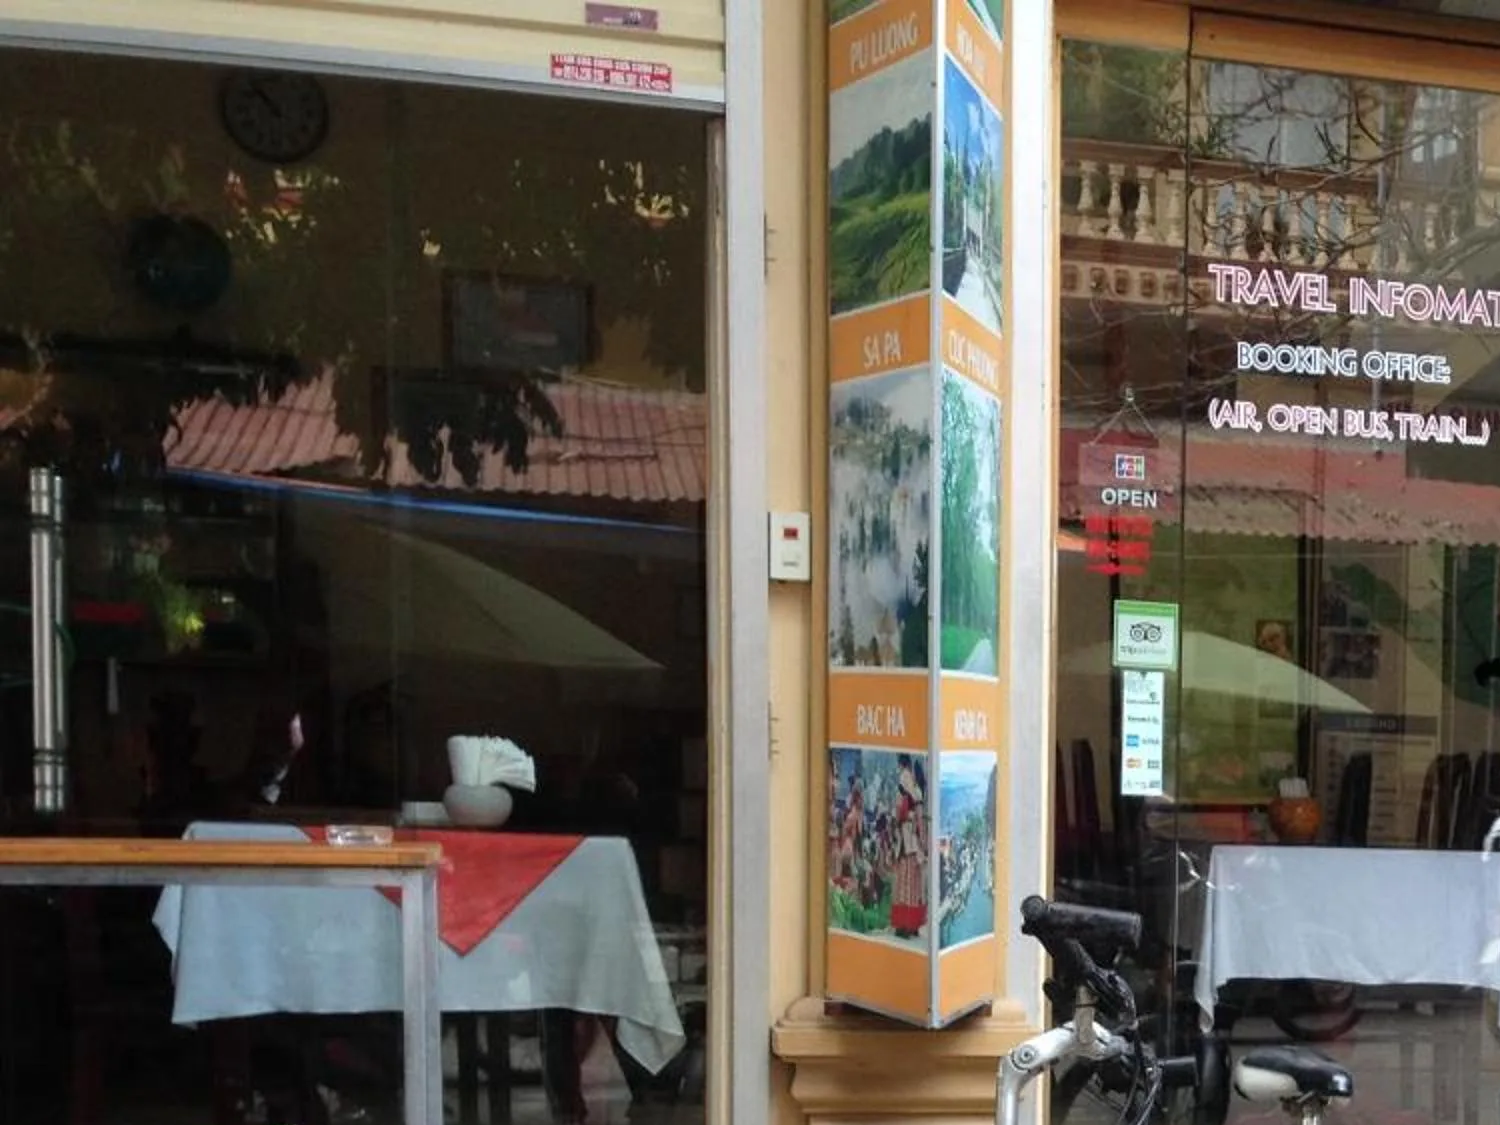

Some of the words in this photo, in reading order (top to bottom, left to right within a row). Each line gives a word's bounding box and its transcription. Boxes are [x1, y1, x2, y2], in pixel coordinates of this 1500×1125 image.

[1207, 263, 1337, 313] TRAVEL
[863, 333, 881, 369] SA
[883, 329, 902, 366] PA
[1236, 341, 1357, 377] BOOKING
[1267, 403, 1338, 436] OPEN
[1100, 487, 1157, 509] OPEN
[856, 702, 882, 736] BAC
[887, 704, 906, 737] HA
